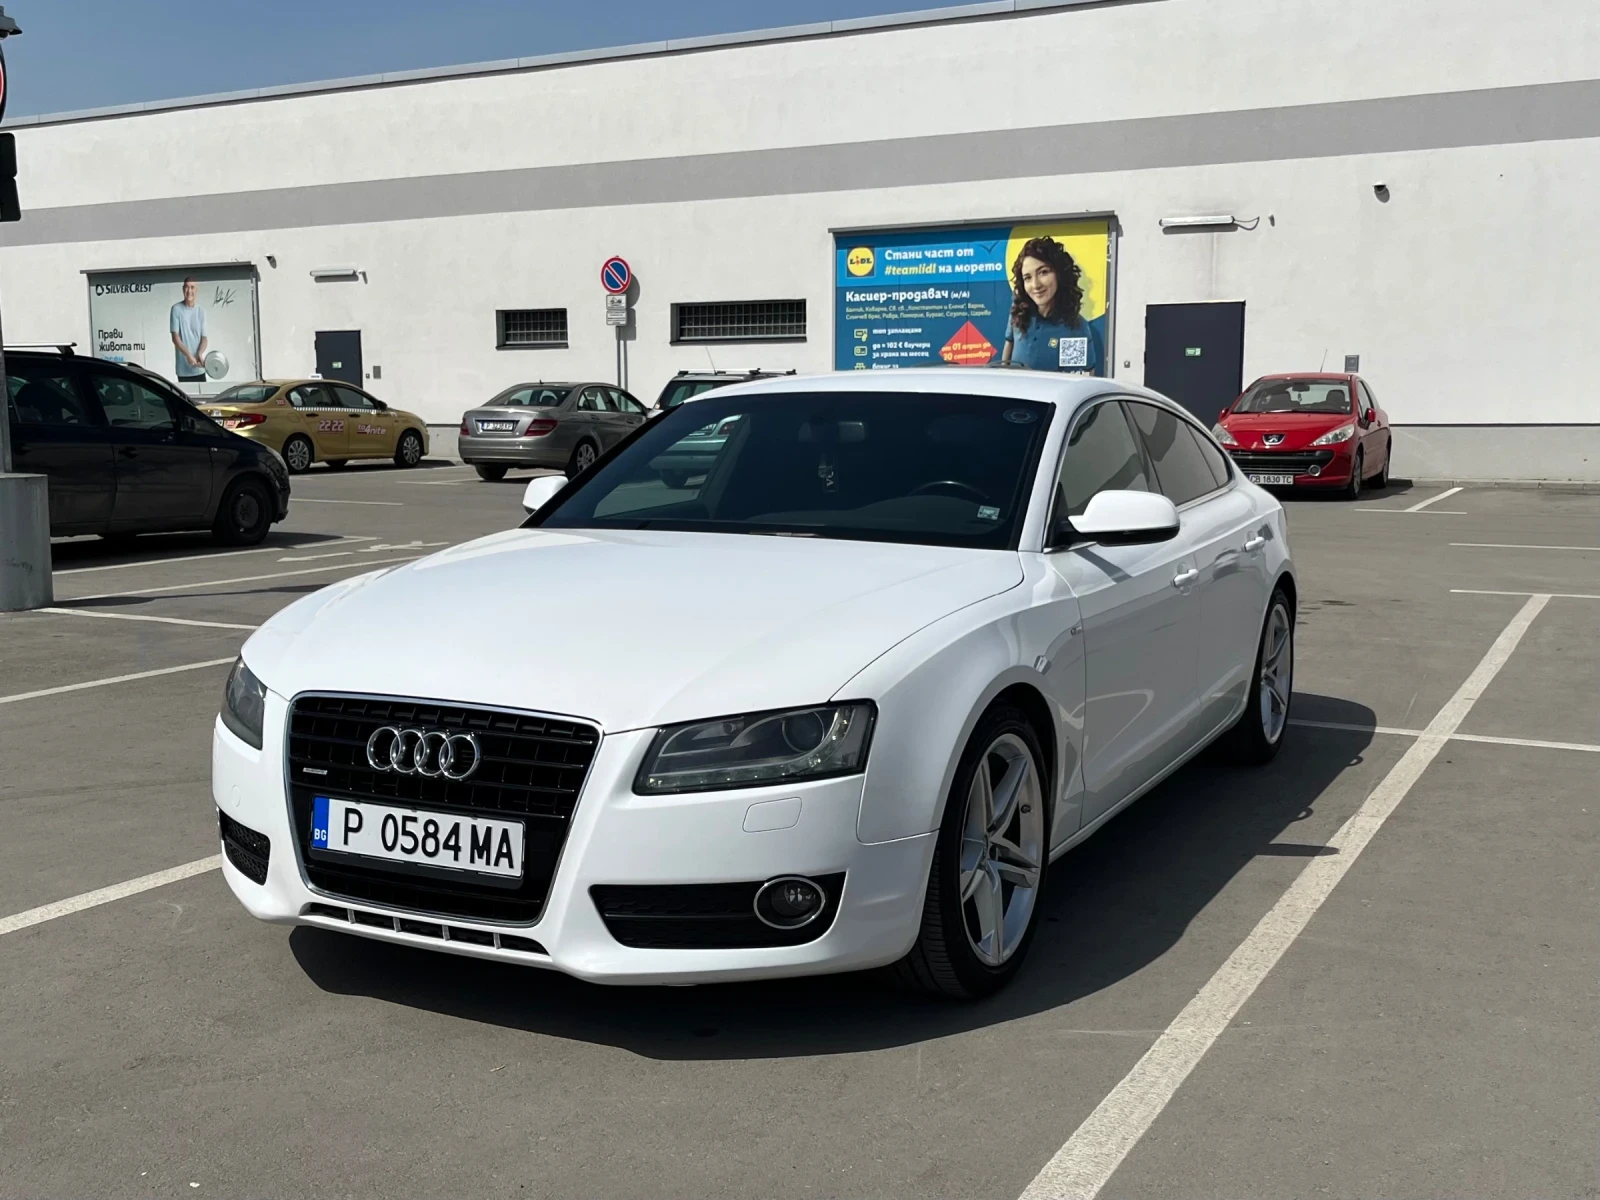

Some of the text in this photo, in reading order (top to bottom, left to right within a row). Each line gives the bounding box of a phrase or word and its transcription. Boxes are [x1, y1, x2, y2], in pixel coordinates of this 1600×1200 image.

[884, 247, 974, 260] Стани част от
[884, 262, 1003, 275] #teamlidl на морето
[845, 288, 949, 303] Касиер-продавач
[98, 328, 123, 341] Прави
[887, 327, 922, 335] заплащане
[98, 341, 146, 351] живота ти
[872, 342, 881, 350] до
[903, 341, 931, 349] ваучери
[872, 351, 880, 359] за
[909, 350, 930, 358] месец
[314, 828, 327, 841] BG
